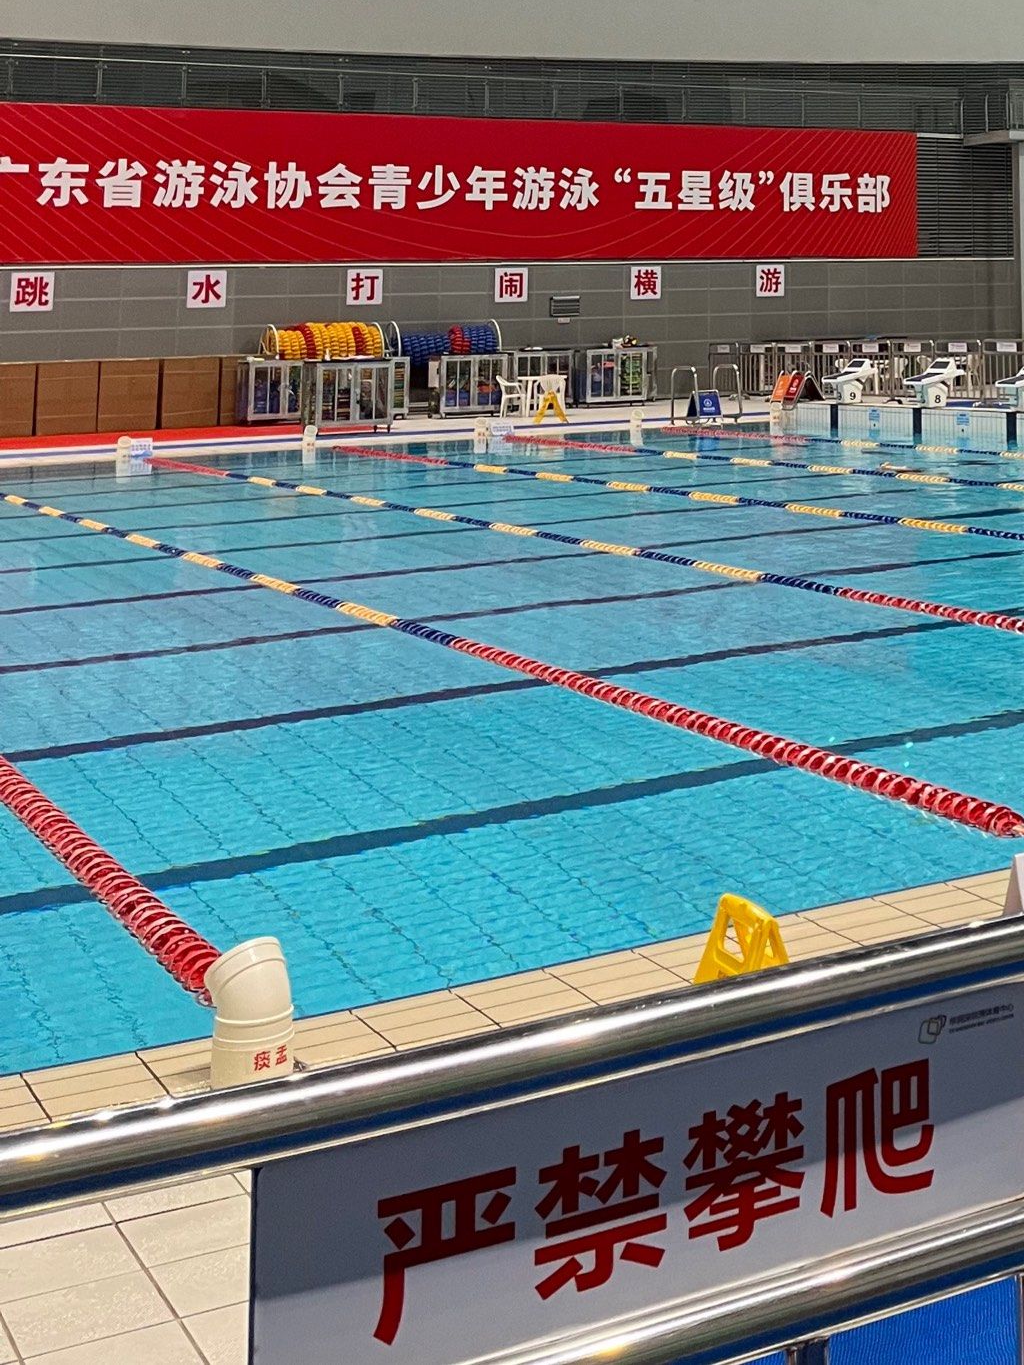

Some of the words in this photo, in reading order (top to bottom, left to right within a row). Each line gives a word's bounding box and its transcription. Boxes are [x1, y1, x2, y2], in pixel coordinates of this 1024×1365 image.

[14, 276, 50, 307] 跳
[192, 274, 222, 304] 水
[351, 272, 379, 301] 打
[499, 272, 524, 298] 闹
[634, 269, 659, 296] 横
[759, 268, 782, 293] 游
[934, 394, 942, 403] 8
[254, 1044, 288, 1071] 痰盂
[372, 1058, 934, 1347] 严禁攀爬
